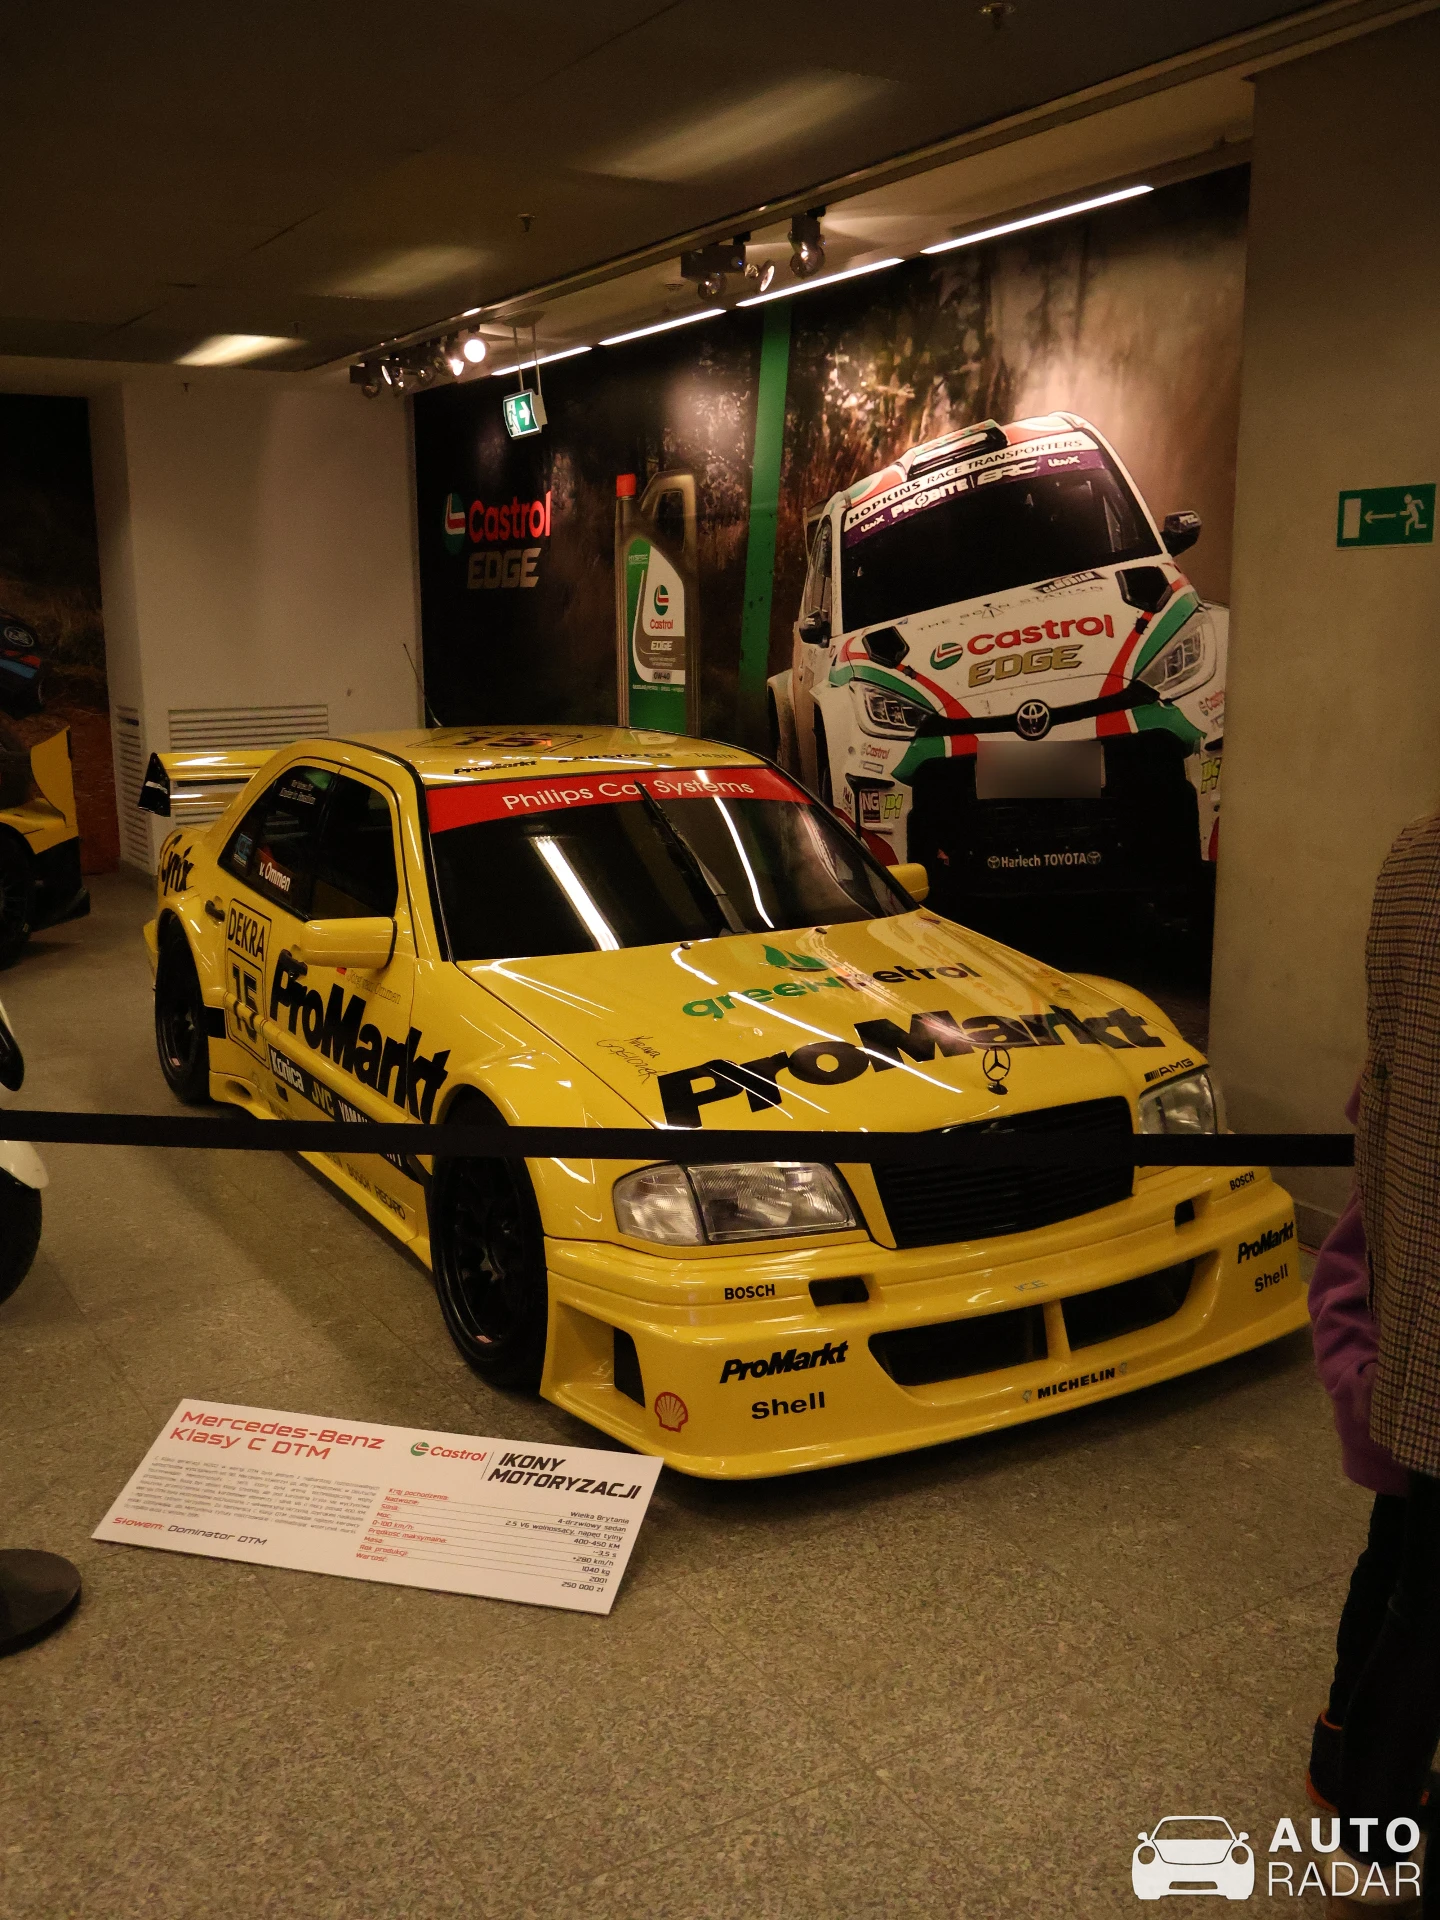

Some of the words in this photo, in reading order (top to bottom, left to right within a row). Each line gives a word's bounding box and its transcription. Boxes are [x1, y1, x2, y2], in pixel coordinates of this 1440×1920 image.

[849, 482, 922, 524] HOPKINS
[926, 466, 962, 485] RACE
[967, 439, 1083, 470] TRANSPORTERS
[468, 490, 552, 544] Castrol
[466, 547, 542, 590] EDGE
[649, 618, 674, 630] Castrol
[967, 614, 1115, 656] Castrol
[650, 640, 674, 652] EDGE
[968, 644, 1085, 689] EDGE
[865, 744, 891, 760] Castrol
[501, 786, 594, 812] Philips
[652, 778, 755, 796] Systems
[1001, 854, 1041, 868] Harlech
[1043, 852, 1088, 866] TOYOTA
[264, 861, 291, 892] Ommen
[227, 907, 265, 962] DEKRA
[231, 963, 259, 1044] 15
[268, 949, 451, 1126] ProMarkt
[270, 1049, 305, 1093] Konica
[656, 1003, 1167, 1128] ProMarkt
[1158, 1057, 1194, 1078] AMG
[311, 1080, 335, 1117] JVC
[1229, 1170, 1256, 1191] BOSCH
[1236, 1221, 1295, 1265] ProMarkt
[724, 1284, 776, 1301] BOSCH
[1254, 1263, 1289, 1293] Shell
[719, 1340, 849, 1384] ProMarkt
[1037, 1367, 1116, 1399] MICHELIN
[751, 1391, 826, 1420] Shell
[167, 1426, 243, 1449] Klasy
[245, 1436, 267, 1451] C
[270, 1440, 332, 1460] DTM
[177, 1411, 387, 1449] Mercedes-Benz
[428, 1445, 488, 1462] Castrol
[497, 1451, 566, 1473] IKONY
[486, 1466, 642, 1500] MOTORYZACJI
[111, 1516, 166, 1530] Słowem:
[166, 1524, 236, 1541] Dominator
[235, 1534, 267, 1545] DTM
[371, 1519, 393, 1527] 0-100
[556, 1517, 602, 1530] 4-drzwiowy
[603, 1524, 627, 1532] sedan
[568, 1511, 595, 1519] Wielka
[595, 1514, 630, 1525] Brytania
[573, 1537, 607, 1547] 400-450
[602, 1533, 623, 1541] tylny
[580, 1565, 600, 1573] 1040
[599, 1568, 611, 1576] kg
[592, 1557, 614, 1566] km/h
